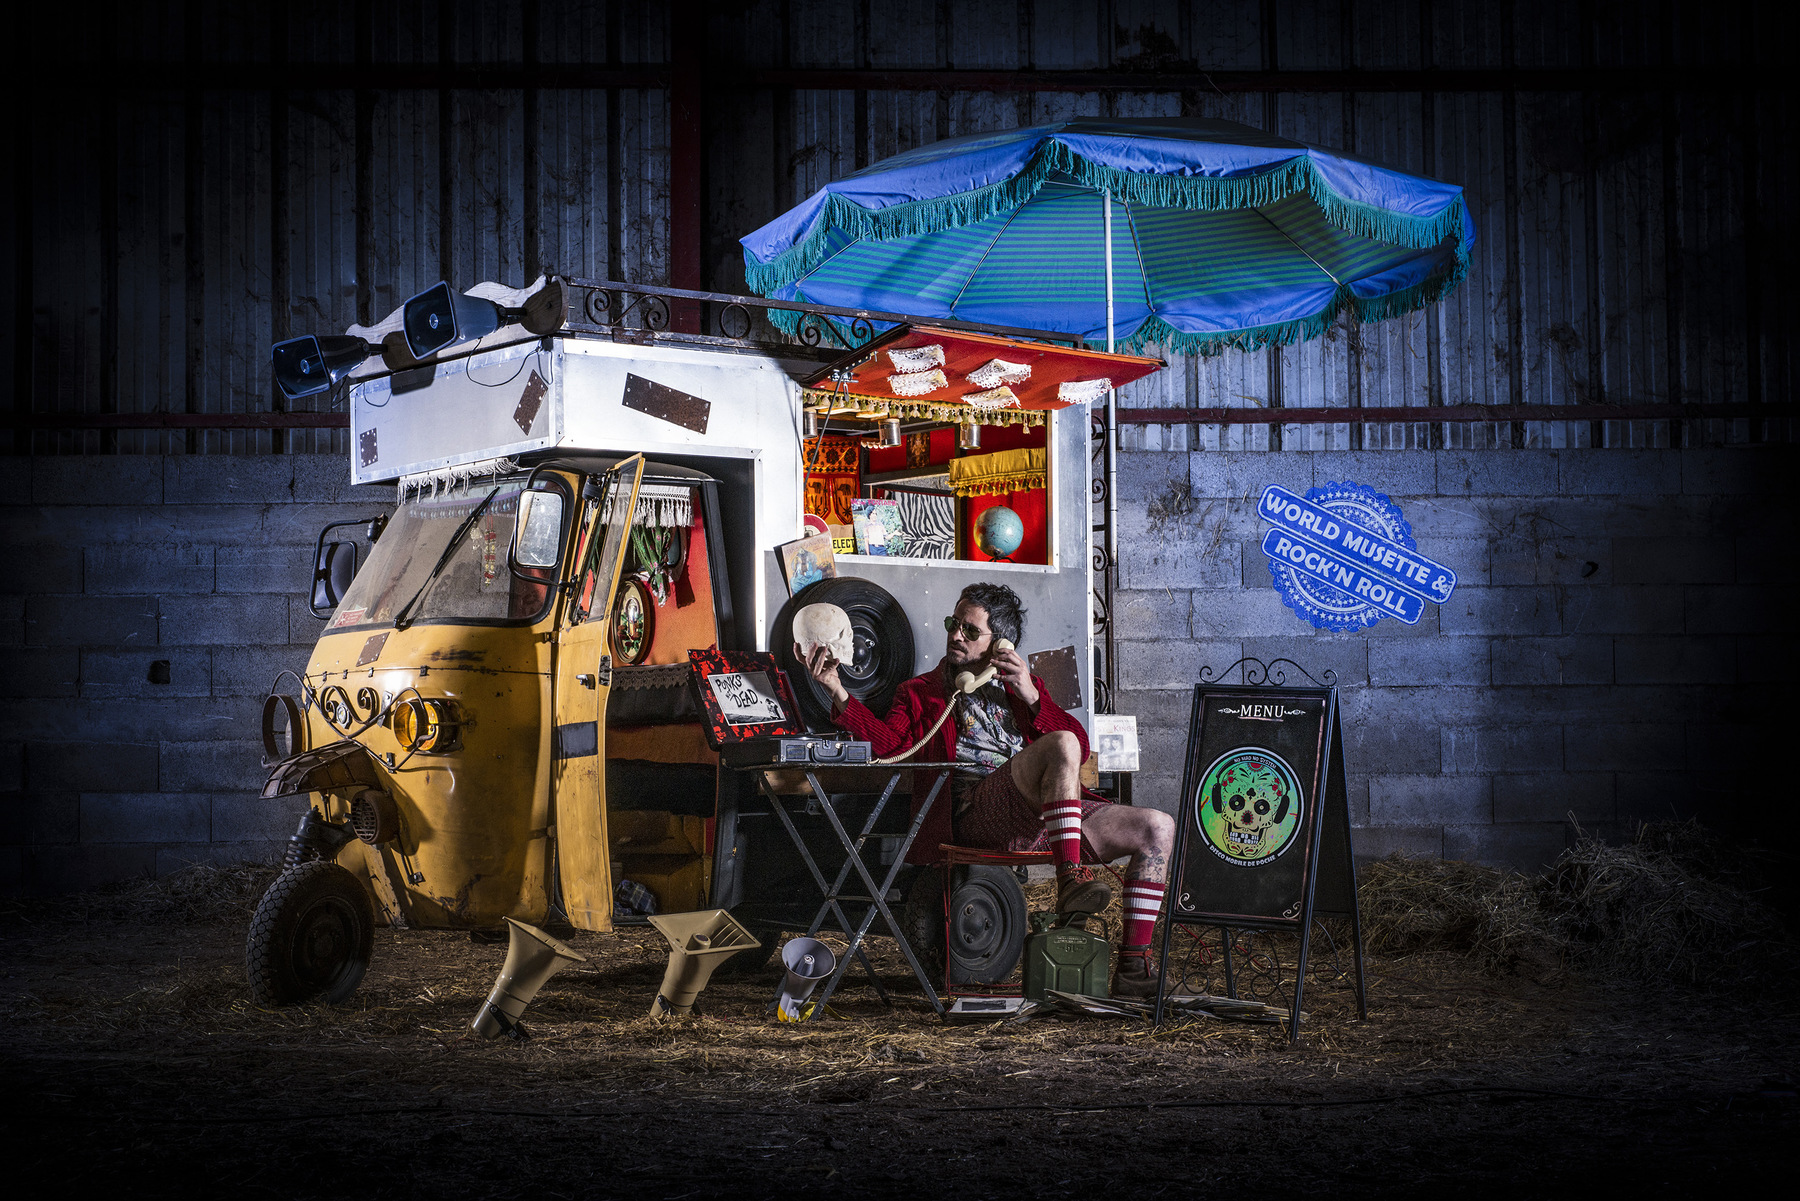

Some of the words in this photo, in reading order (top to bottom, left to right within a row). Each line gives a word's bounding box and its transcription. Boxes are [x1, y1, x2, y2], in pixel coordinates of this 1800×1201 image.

[1266, 493, 1340, 540] WORLD
[1342, 530, 1431, 585] MUSETTE
[1431, 574, 1448, 594] &
[1355, 578, 1407, 616] ROLL
[1240, 704, 1285, 718] MENU
[1259, 757, 1277, 769] SYSTEM
[1209, 844, 1225, 859] DISCO
[1224, 855, 1247, 867] MOBILE
[1255, 854, 1277, 866] POCHE
